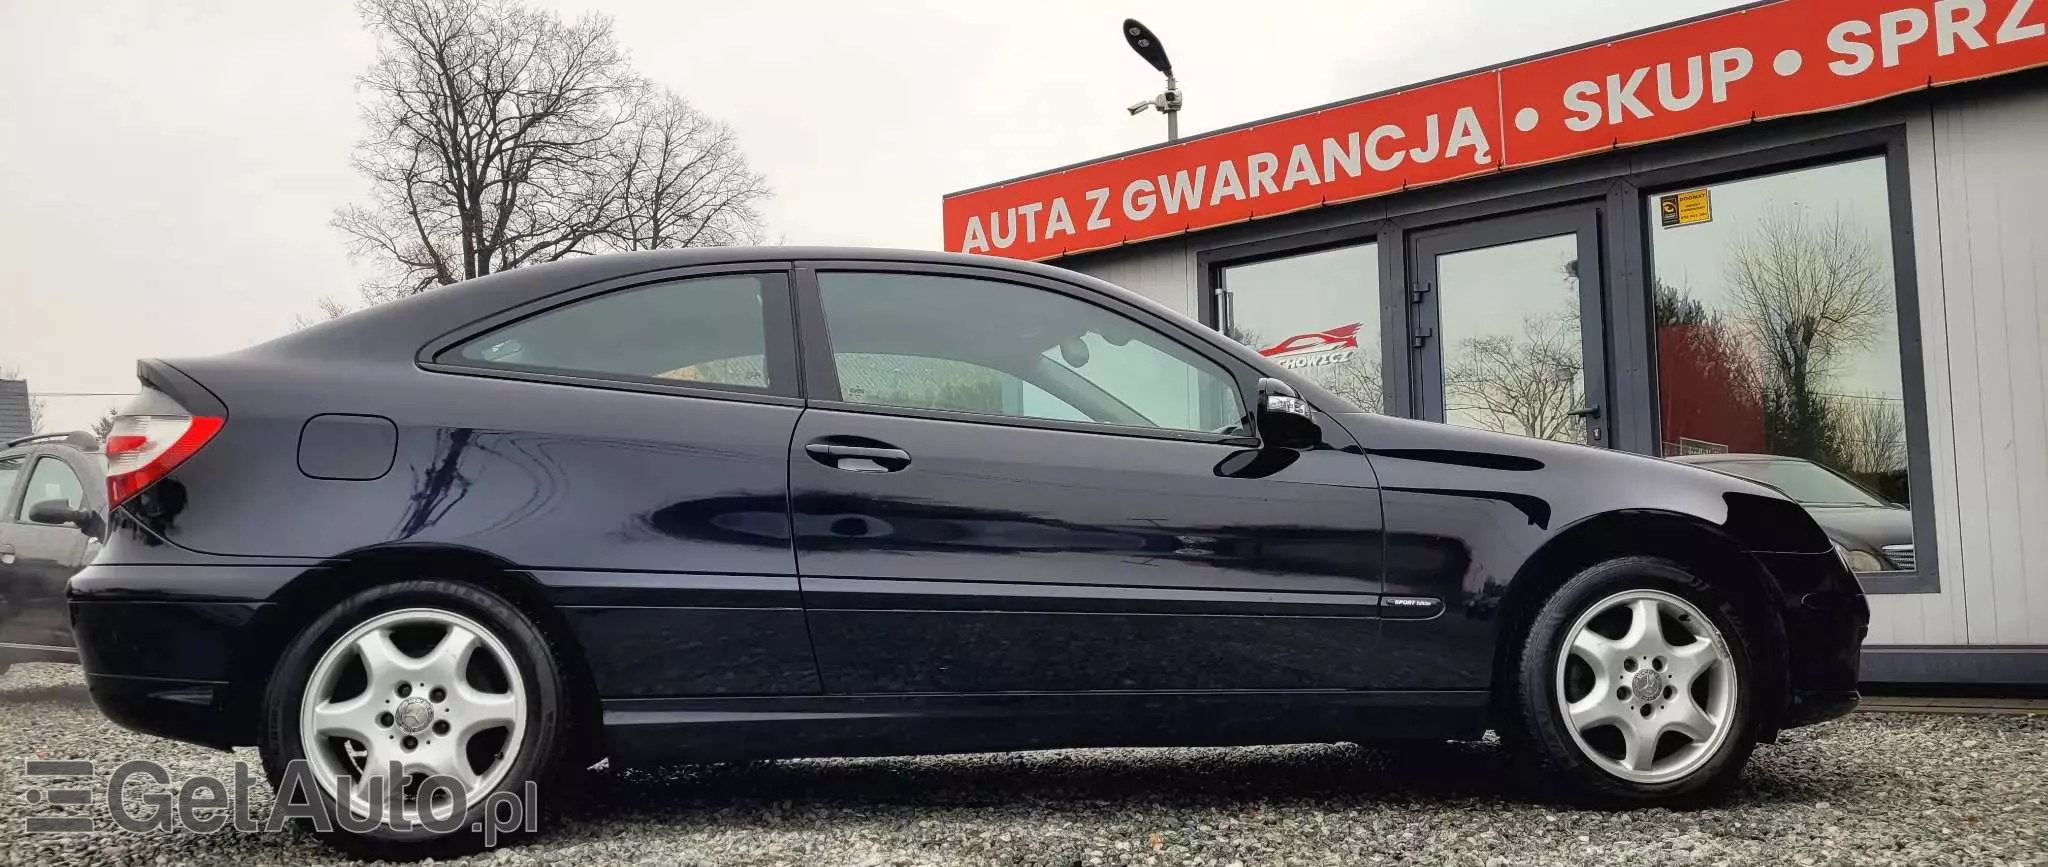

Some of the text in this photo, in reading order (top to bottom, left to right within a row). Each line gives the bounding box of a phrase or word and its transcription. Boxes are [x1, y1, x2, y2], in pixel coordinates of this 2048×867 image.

[961, 0, 2046, 255] AUTA Z GWARANCJĄ SKUP SPRZ
